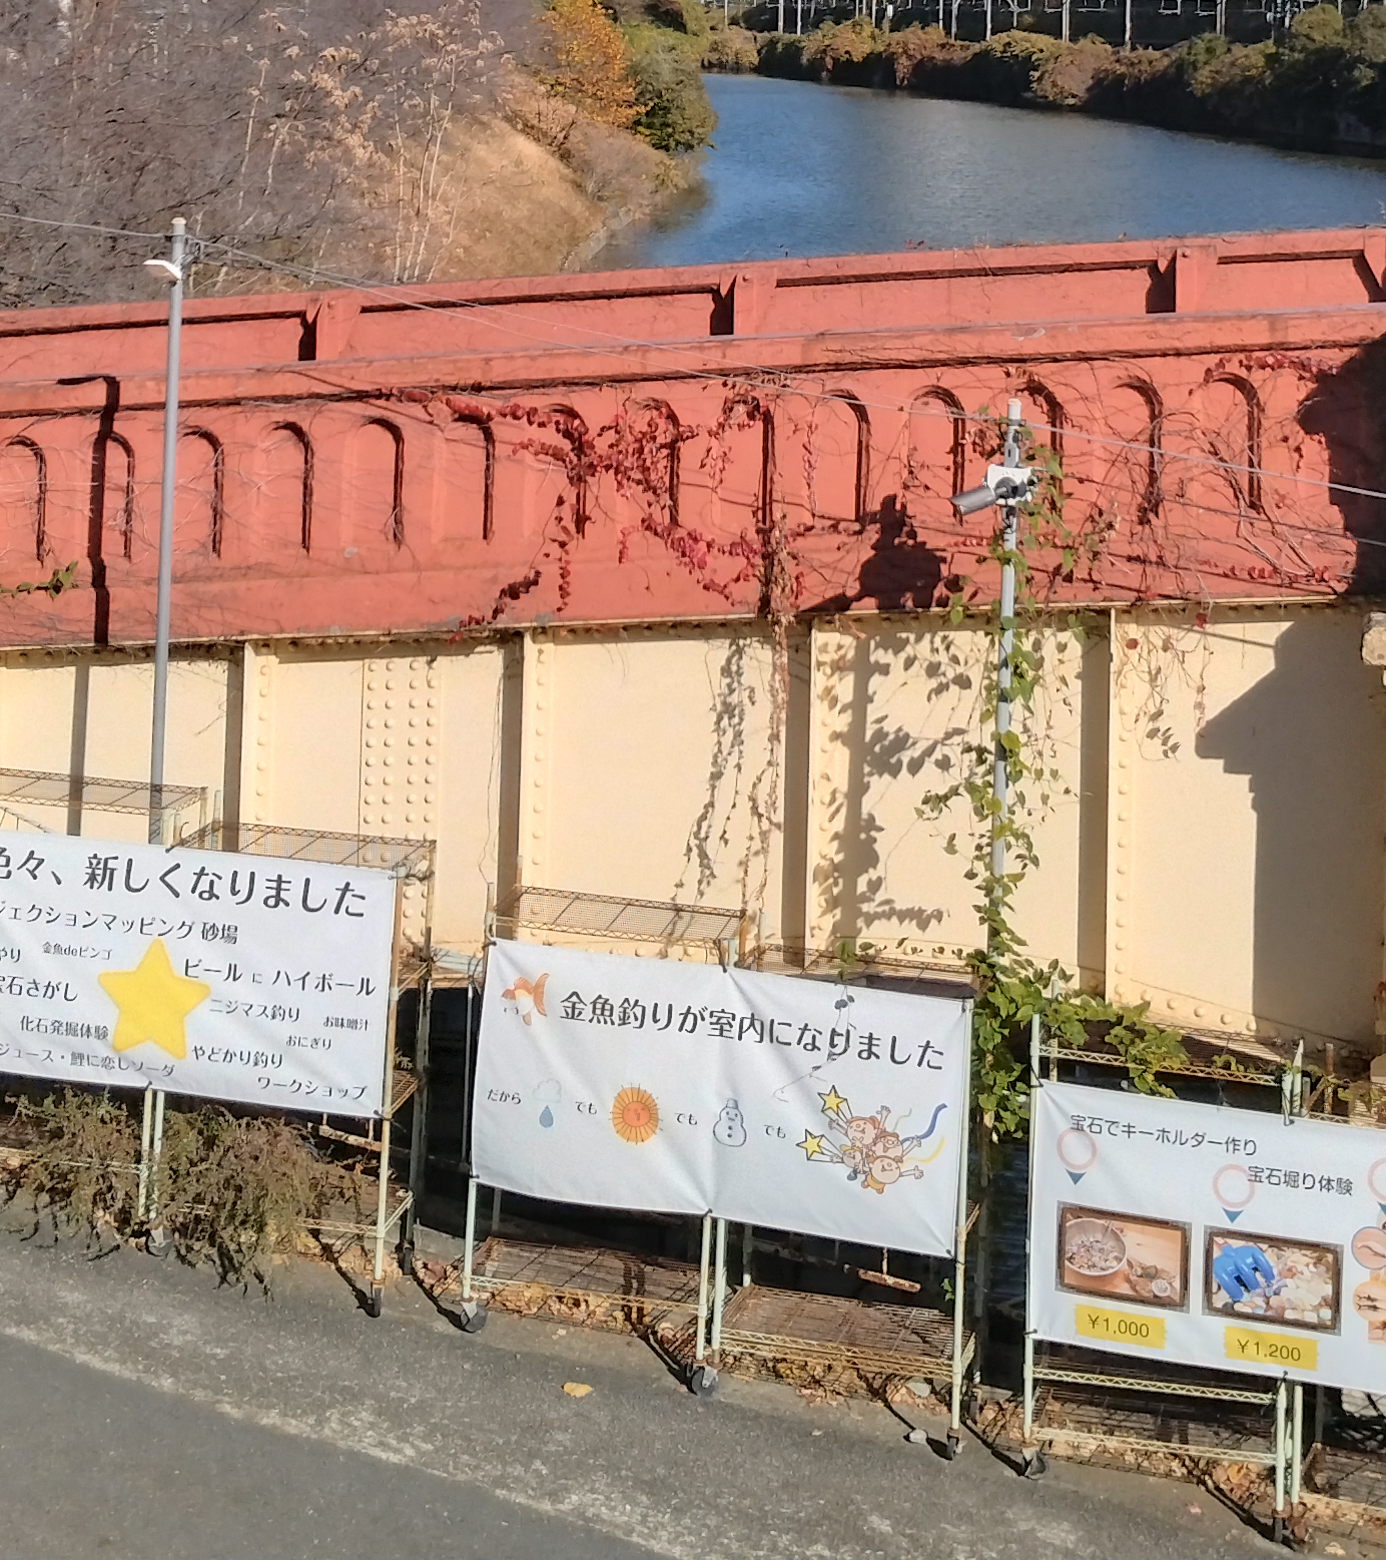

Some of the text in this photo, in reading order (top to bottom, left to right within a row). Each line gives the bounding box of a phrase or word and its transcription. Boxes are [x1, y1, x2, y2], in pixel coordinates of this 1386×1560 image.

[201, 921, 239, 945] 砂場
[184, 958, 244, 983] ビール
[272, 969, 377, 997] ハイボール
[210, 998, 301, 1022] ニジマス釣り
[20, 1015, 110, 1042] 化石発掘体験
[559, 991, 945, 1070] 金魚釣りが室内になりました
[285, 1035, 332, 1051] おにぎり
[191, 1045, 283, 1069] やどかり釣り
[486, 1088, 786, 1139] だから でも でも でも
[1070, 1114, 1258, 1156] 宝石でキーホルダー作り
